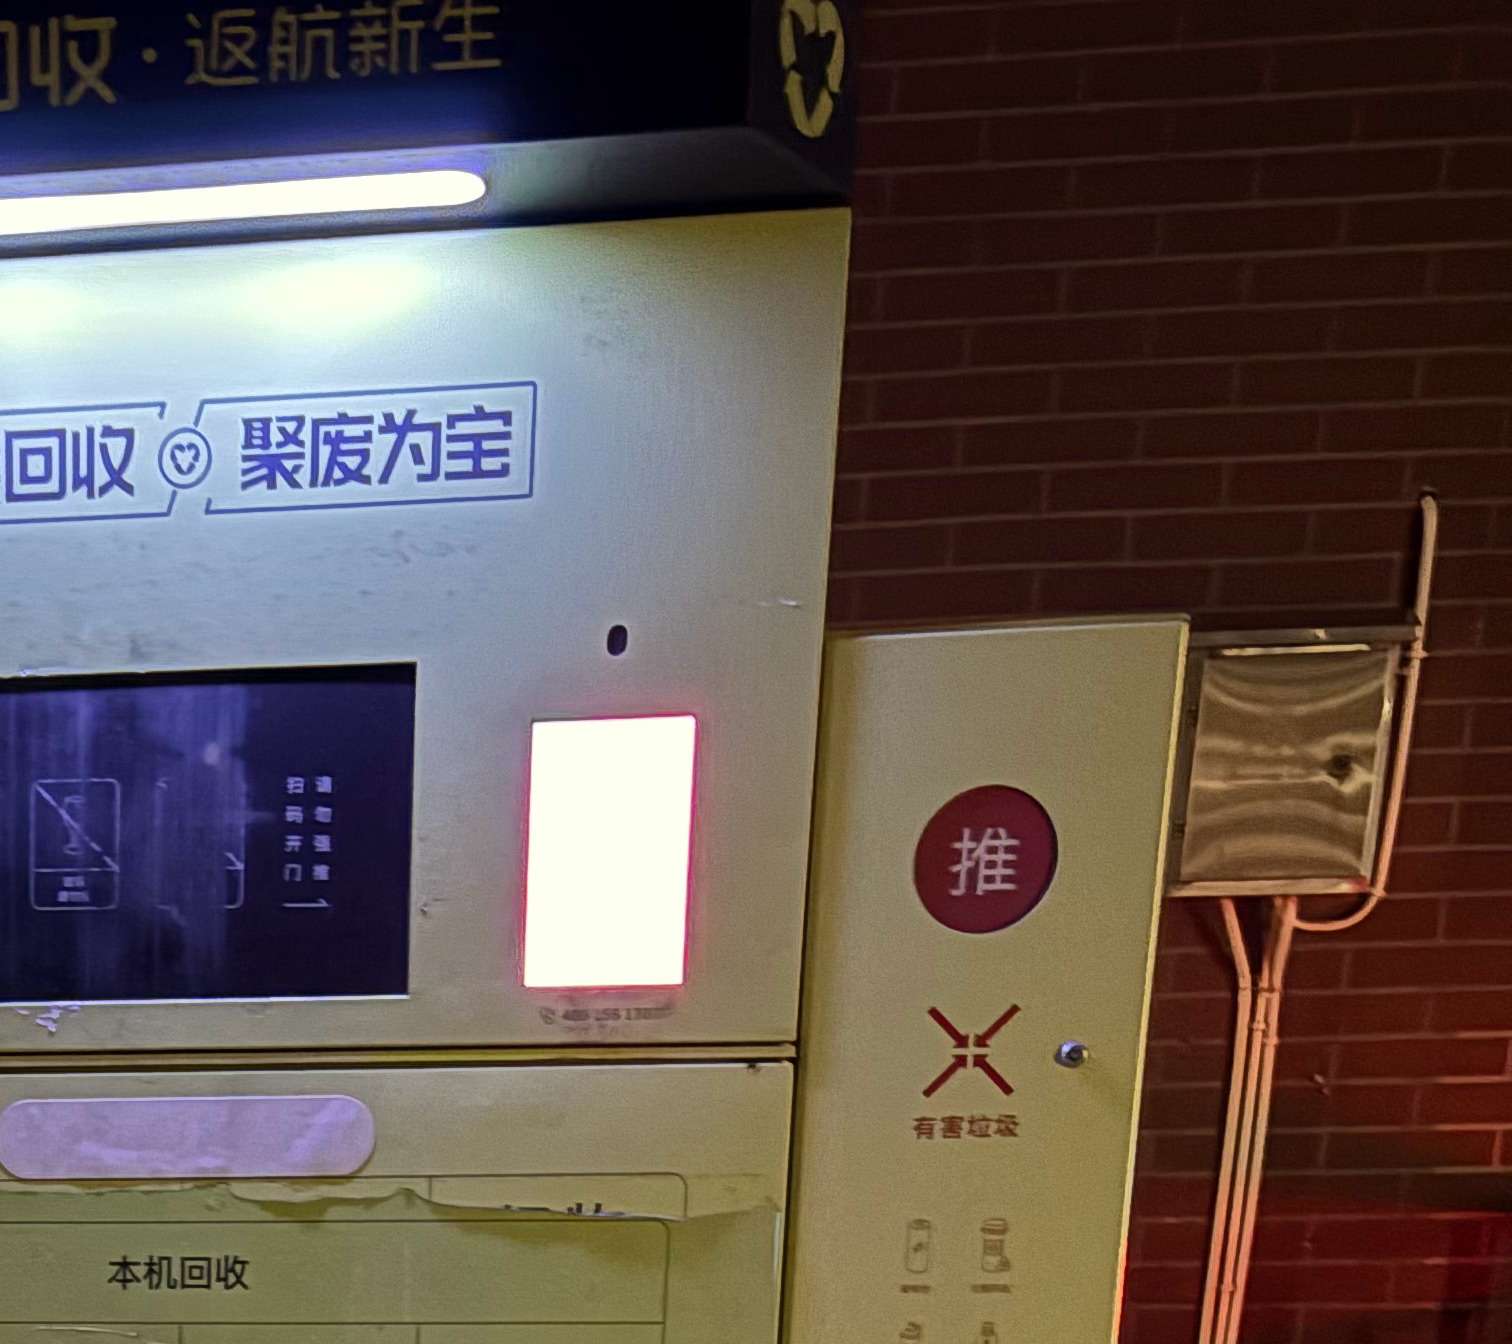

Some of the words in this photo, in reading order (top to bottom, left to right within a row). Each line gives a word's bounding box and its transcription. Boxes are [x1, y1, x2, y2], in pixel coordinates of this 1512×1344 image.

[241, 405, 513, 491] 聚废为宝
[948, 826, 1021, 897] 推
[912, 1114, 1020, 1140] 有害垃圾
[107, 1254, 250, 1291] 本机回收
